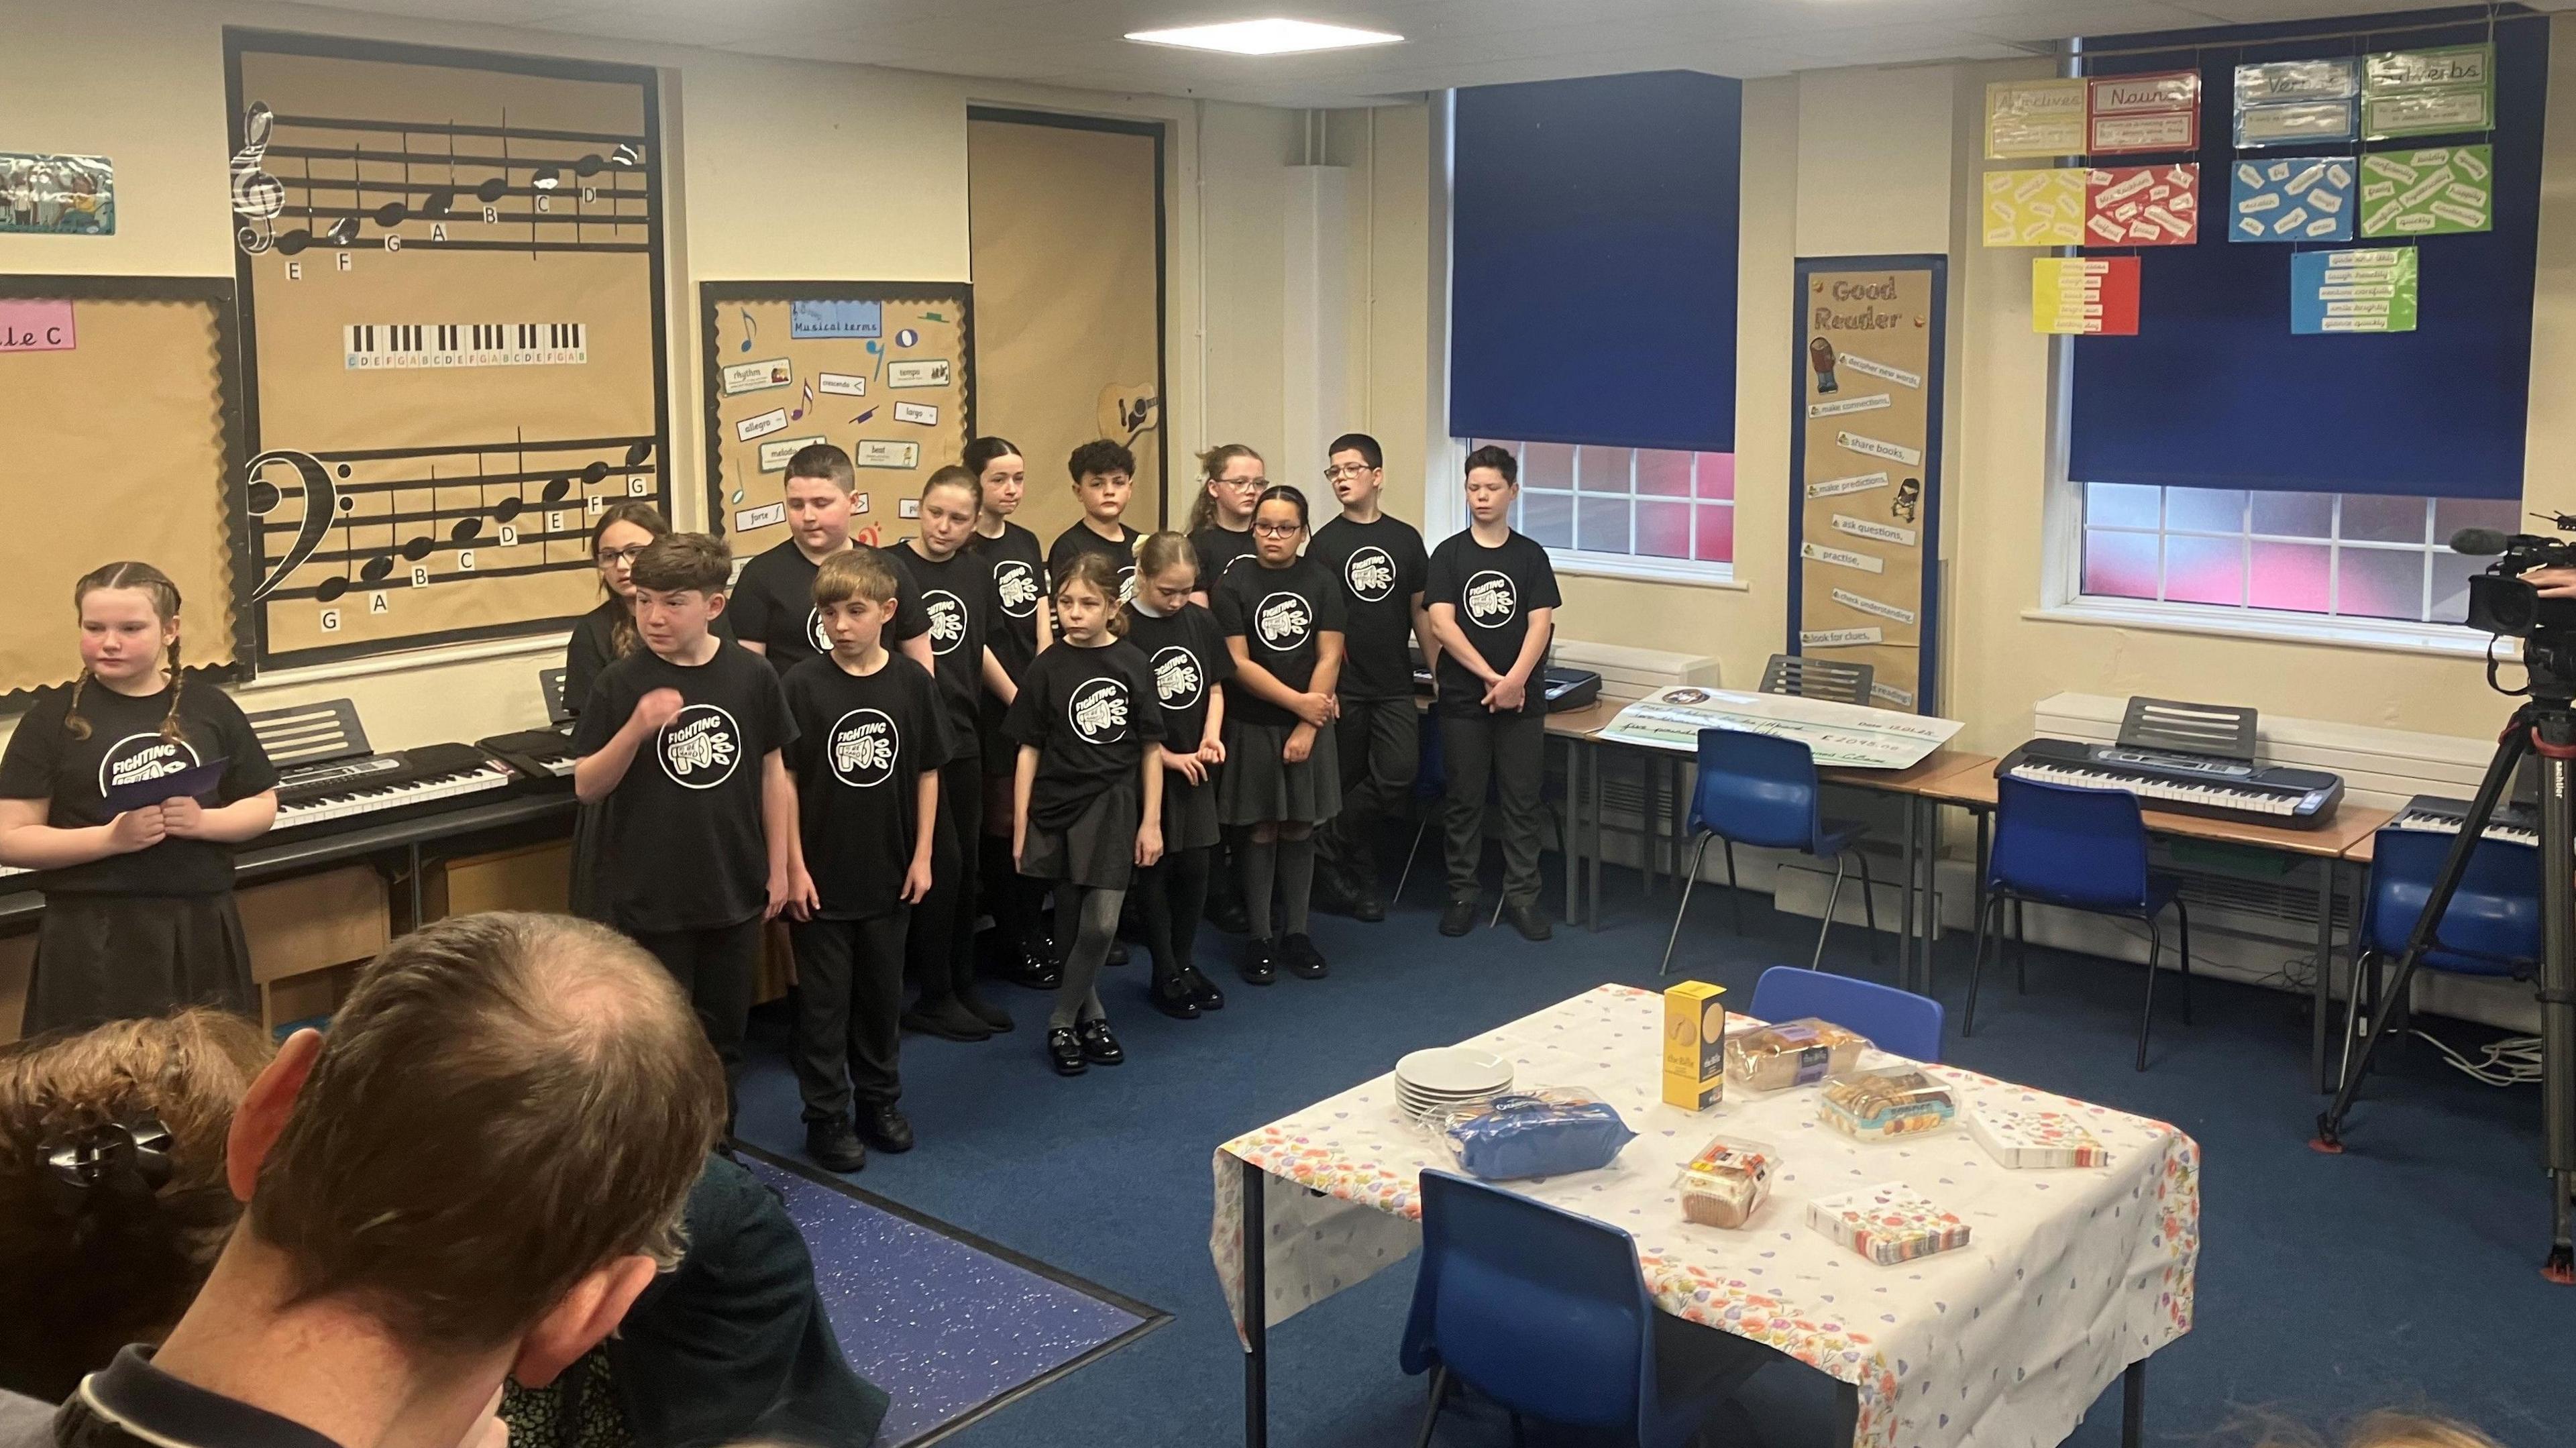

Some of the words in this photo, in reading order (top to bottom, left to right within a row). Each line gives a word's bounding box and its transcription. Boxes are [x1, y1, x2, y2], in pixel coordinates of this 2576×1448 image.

[585, 188, 594, 203] D
[538, 196, 549, 212] C
[485, 207, 496, 223] B
[2399, 217, 2431, 226] quickly
[433, 224, 445, 241] A
[387, 235, 400, 252] G
[339, 254, 349, 270] F
[289, 262, 299, 280] E
[1832, 276, 1898, 301] Good
[1814, 305, 1902, 330] Reader
[796, 322, 841, 332] Musical
[844, 321, 877, 331] terms
[0, 326, 38, 346] le
[46, 327, 61, 345] C
[361, 357, 368, 366] D
[374, 357, 380, 365] E
[386, 356, 392, 365] F
[398, 356, 405, 365] G
[410, 356, 417, 364] A
[422, 355, 429, 364] B
[433, 355, 440, 364] C
[445, 355, 451, 364] D
[457, 355, 464, 364] E
[480, 355, 486, 363] G
[513, 354, 520, 362] C
[733, 370, 761, 380] rhythm
[745, 419, 771, 434] allegro
[1851, 438, 1874, 451] share
[631, 478, 643, 494] G
[591, 497, 599, 512] F
[552, 514, 560, 528] E
[751, 512, 769, 525] forte
[1841, 520, 1856, 530] ask
[502, 528, 514, 543] D
[460, 552, 472, 568] C
[1352, 555, 1385, 570] FIGHTING
[415, 569, 427, 585] B
[1469, 579, 1505, 596] FIGHTING
[373, 595, 387, 611] A
[1263, 598, 1297, 618] FIGHTING
[323, 613, 336, 628] G
[1075, 685, 1117, 712] FIGHTING
[669, 715, 721, 744] FIGHTING
[837, 722, 886, 742] FIGHTING
[113, 744, 176, 775] FIGHTING
